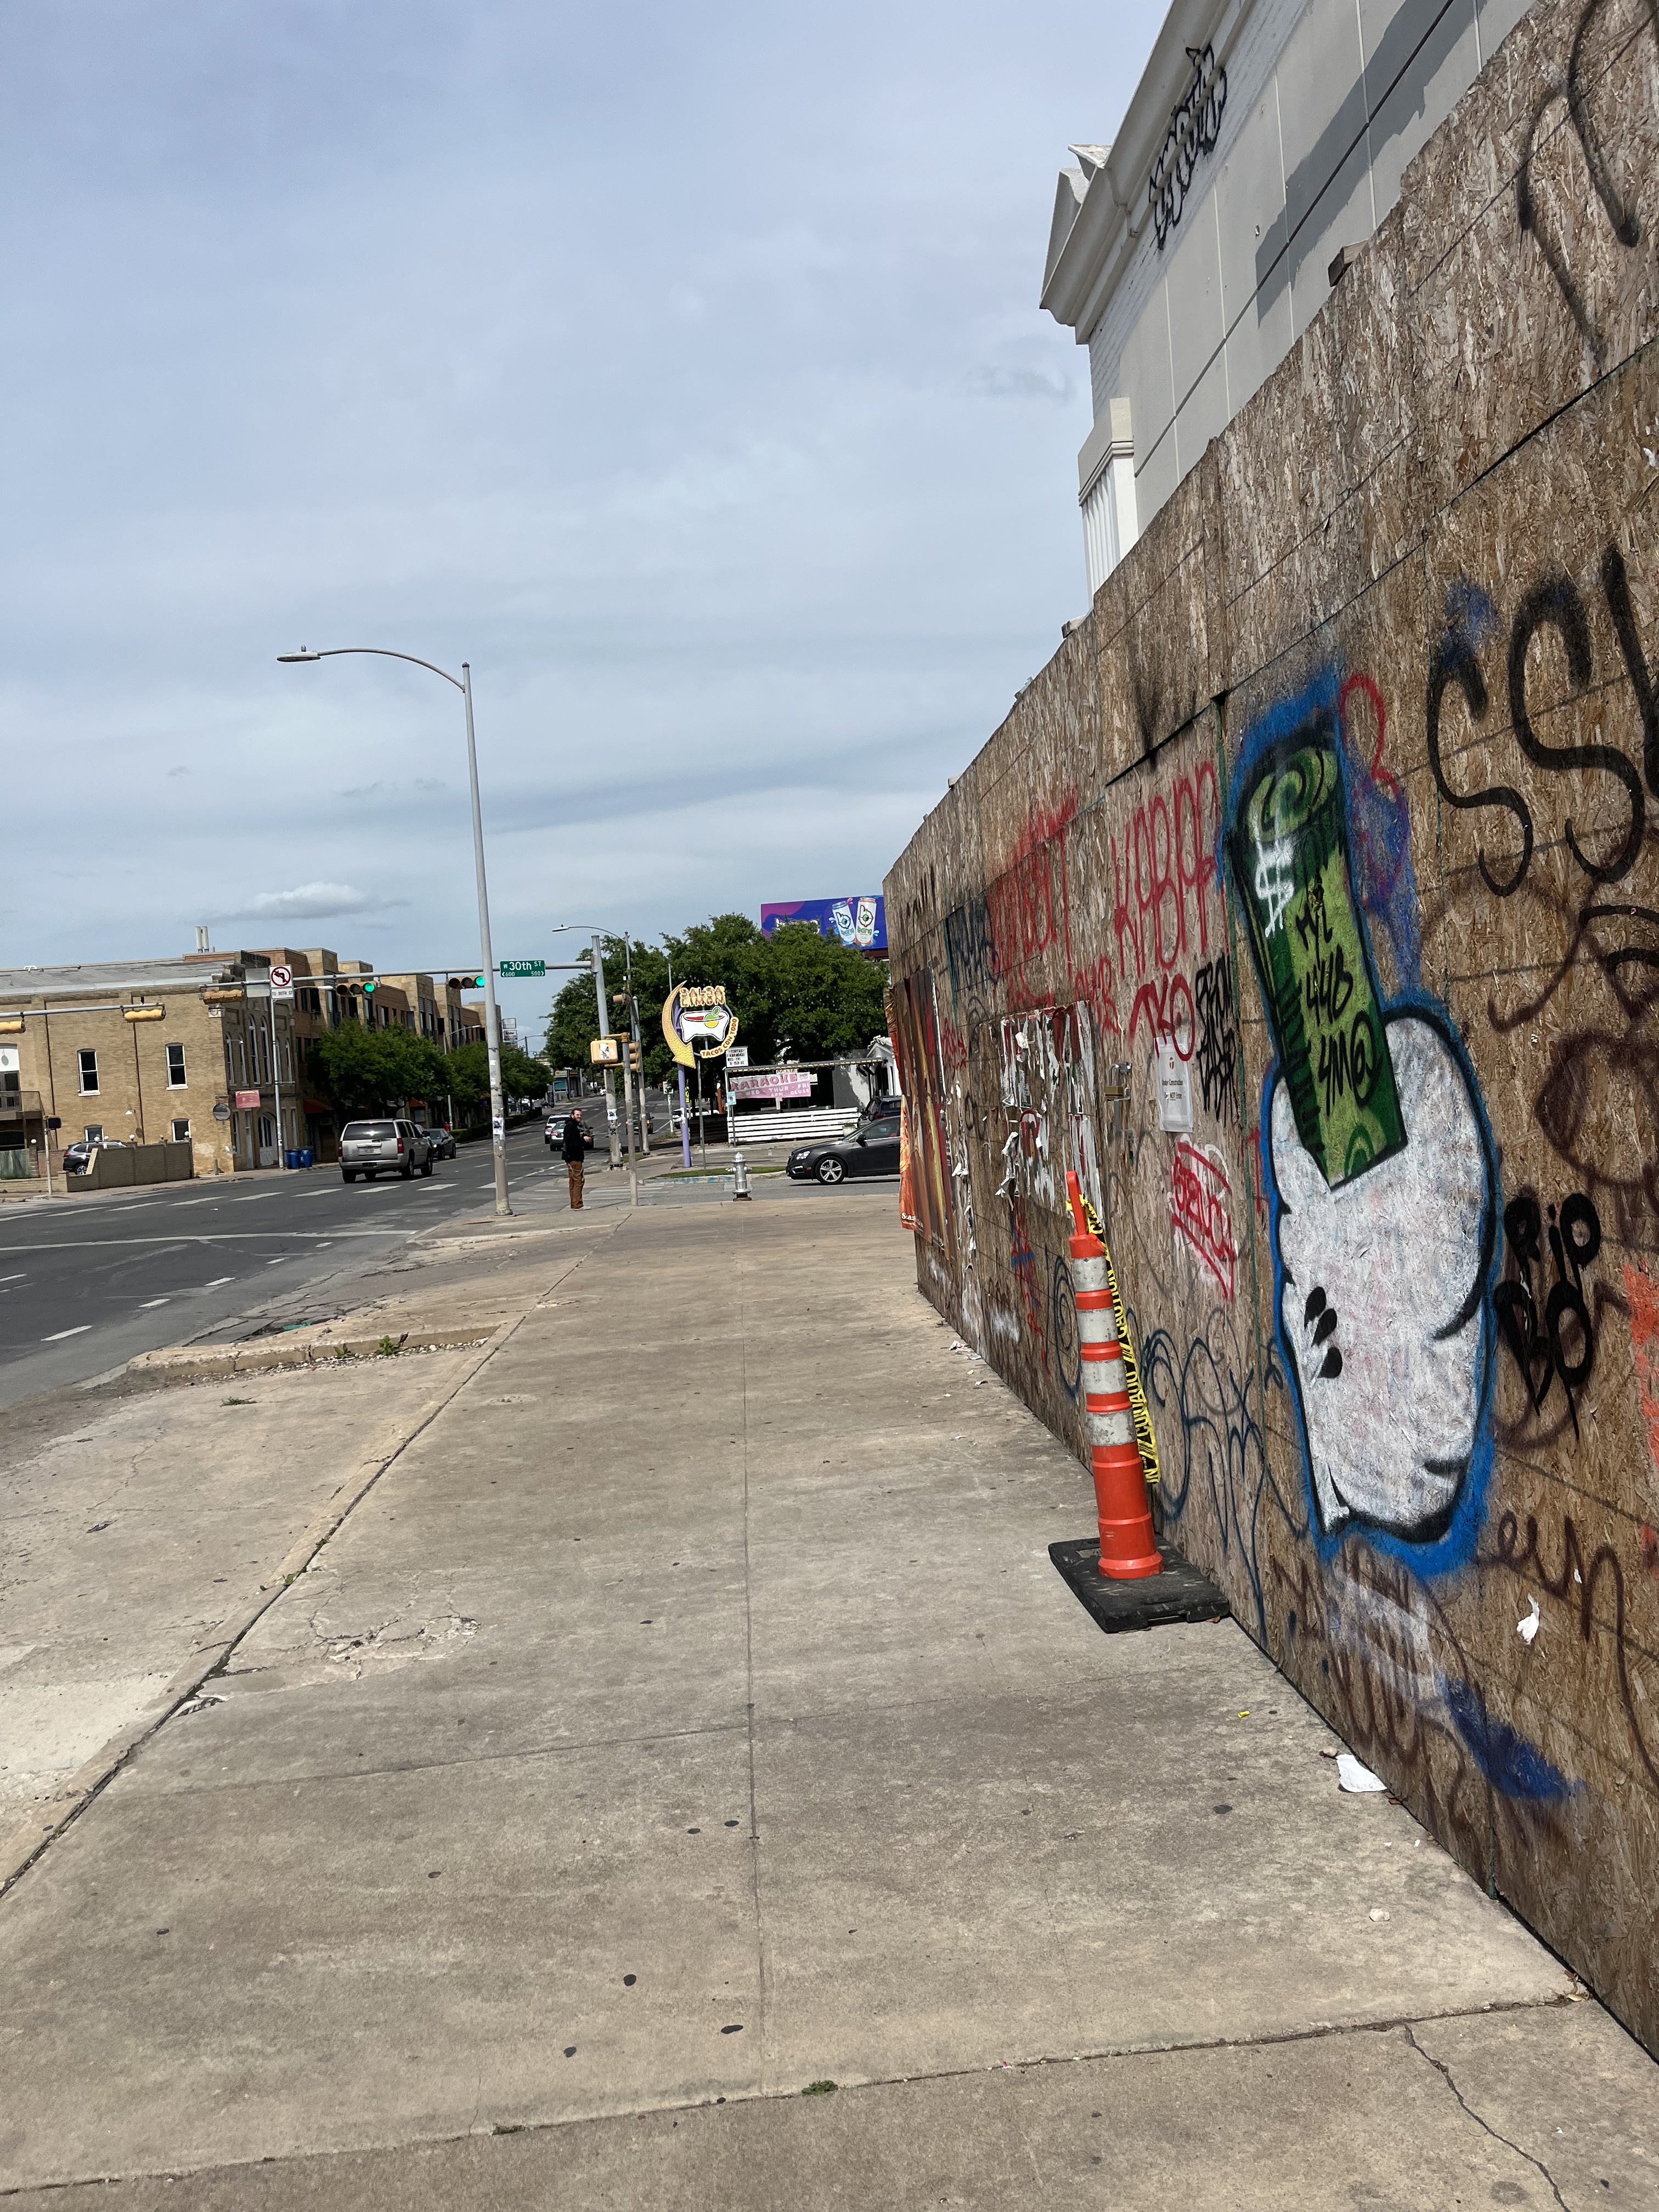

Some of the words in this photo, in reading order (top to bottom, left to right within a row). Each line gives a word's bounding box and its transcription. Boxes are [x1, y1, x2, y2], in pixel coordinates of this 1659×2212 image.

[509, 961, 532, 970] 30th
[680, 987, 723, 997] SALSA
[702, 1047, 723, 1057] TACOS
[723, 1036, 733, 1049] CON
[730, 1074, 797, 1091] KARAOKE
[1107, 1270, 1128, 1339] CAUTION
